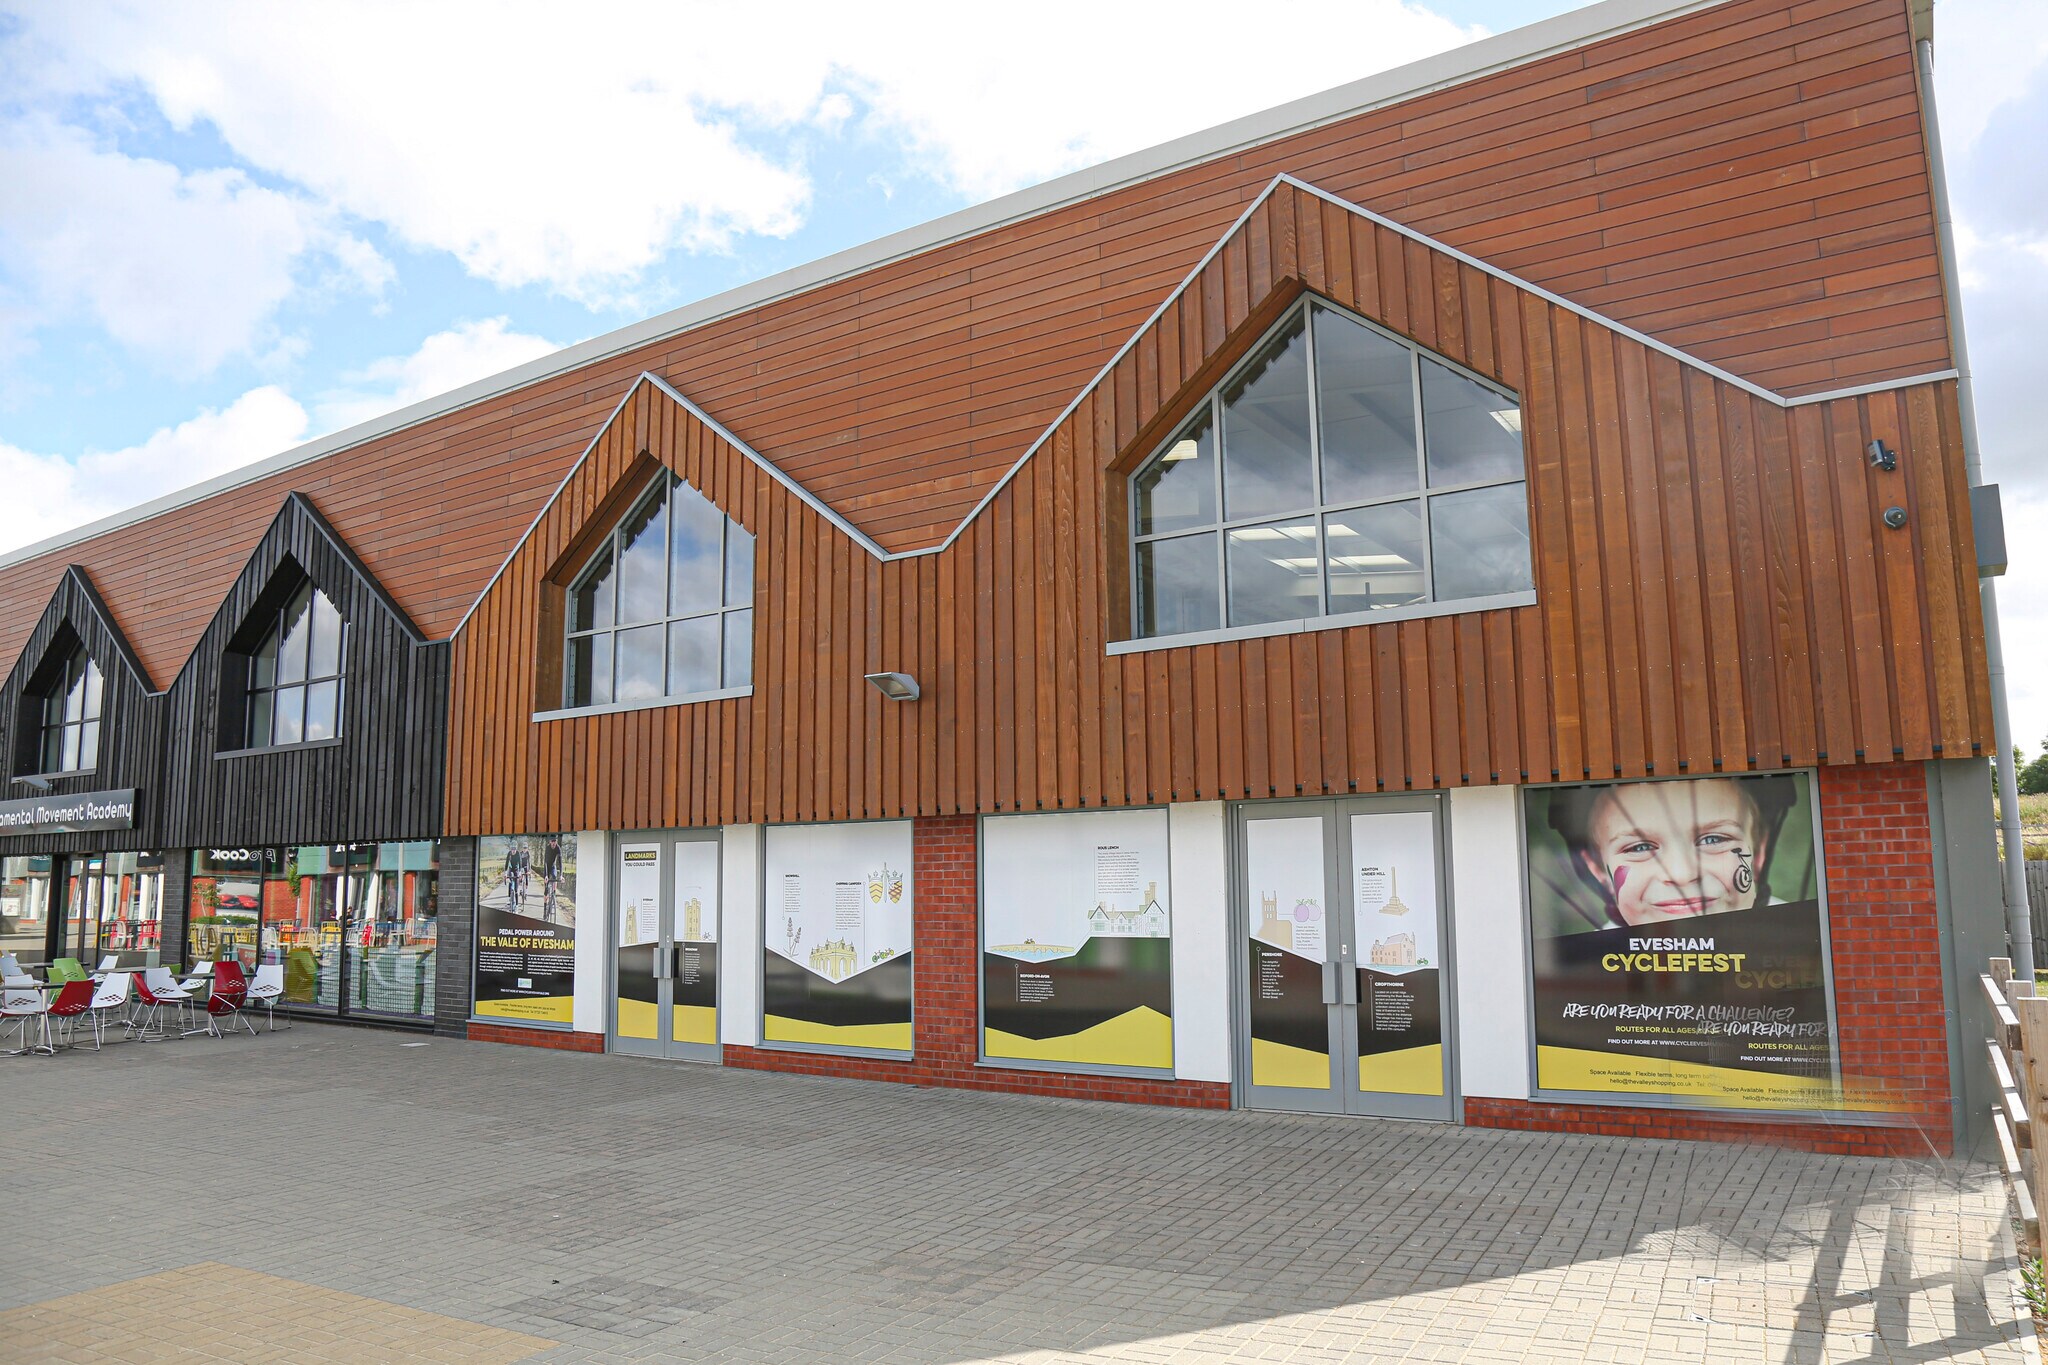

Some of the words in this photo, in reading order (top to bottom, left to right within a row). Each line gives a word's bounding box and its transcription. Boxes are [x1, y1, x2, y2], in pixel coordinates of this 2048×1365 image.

[36, 804, 84, 824] Movement
[87, 801, 133, 821] Academy
[480, 936, 496, 946] THE
[498, 936, 518, 947] VALE
[520, 938, 531, 948] OF
[532, 938, 574, 950] EVESHAM
[1629, 937, 1715, 951] EVESHAM
[1601, 953, 1746, 973] CYCLEFEST
[1563, 1003, 1590, 1018] ARE
[1591, 1004, 1617, 1019] YOU
[1618, 1003, 1663, 1020] READY
[1665, 1005, 1694, 1020] FOR
[1696, 1005, 1705, 1020] A
[1708, 1005, 1795, 1022] CHALLENGE?
[1751, 1021, 1796, 1038] READY
[1798, 1021, 1827, 1037] FOR
